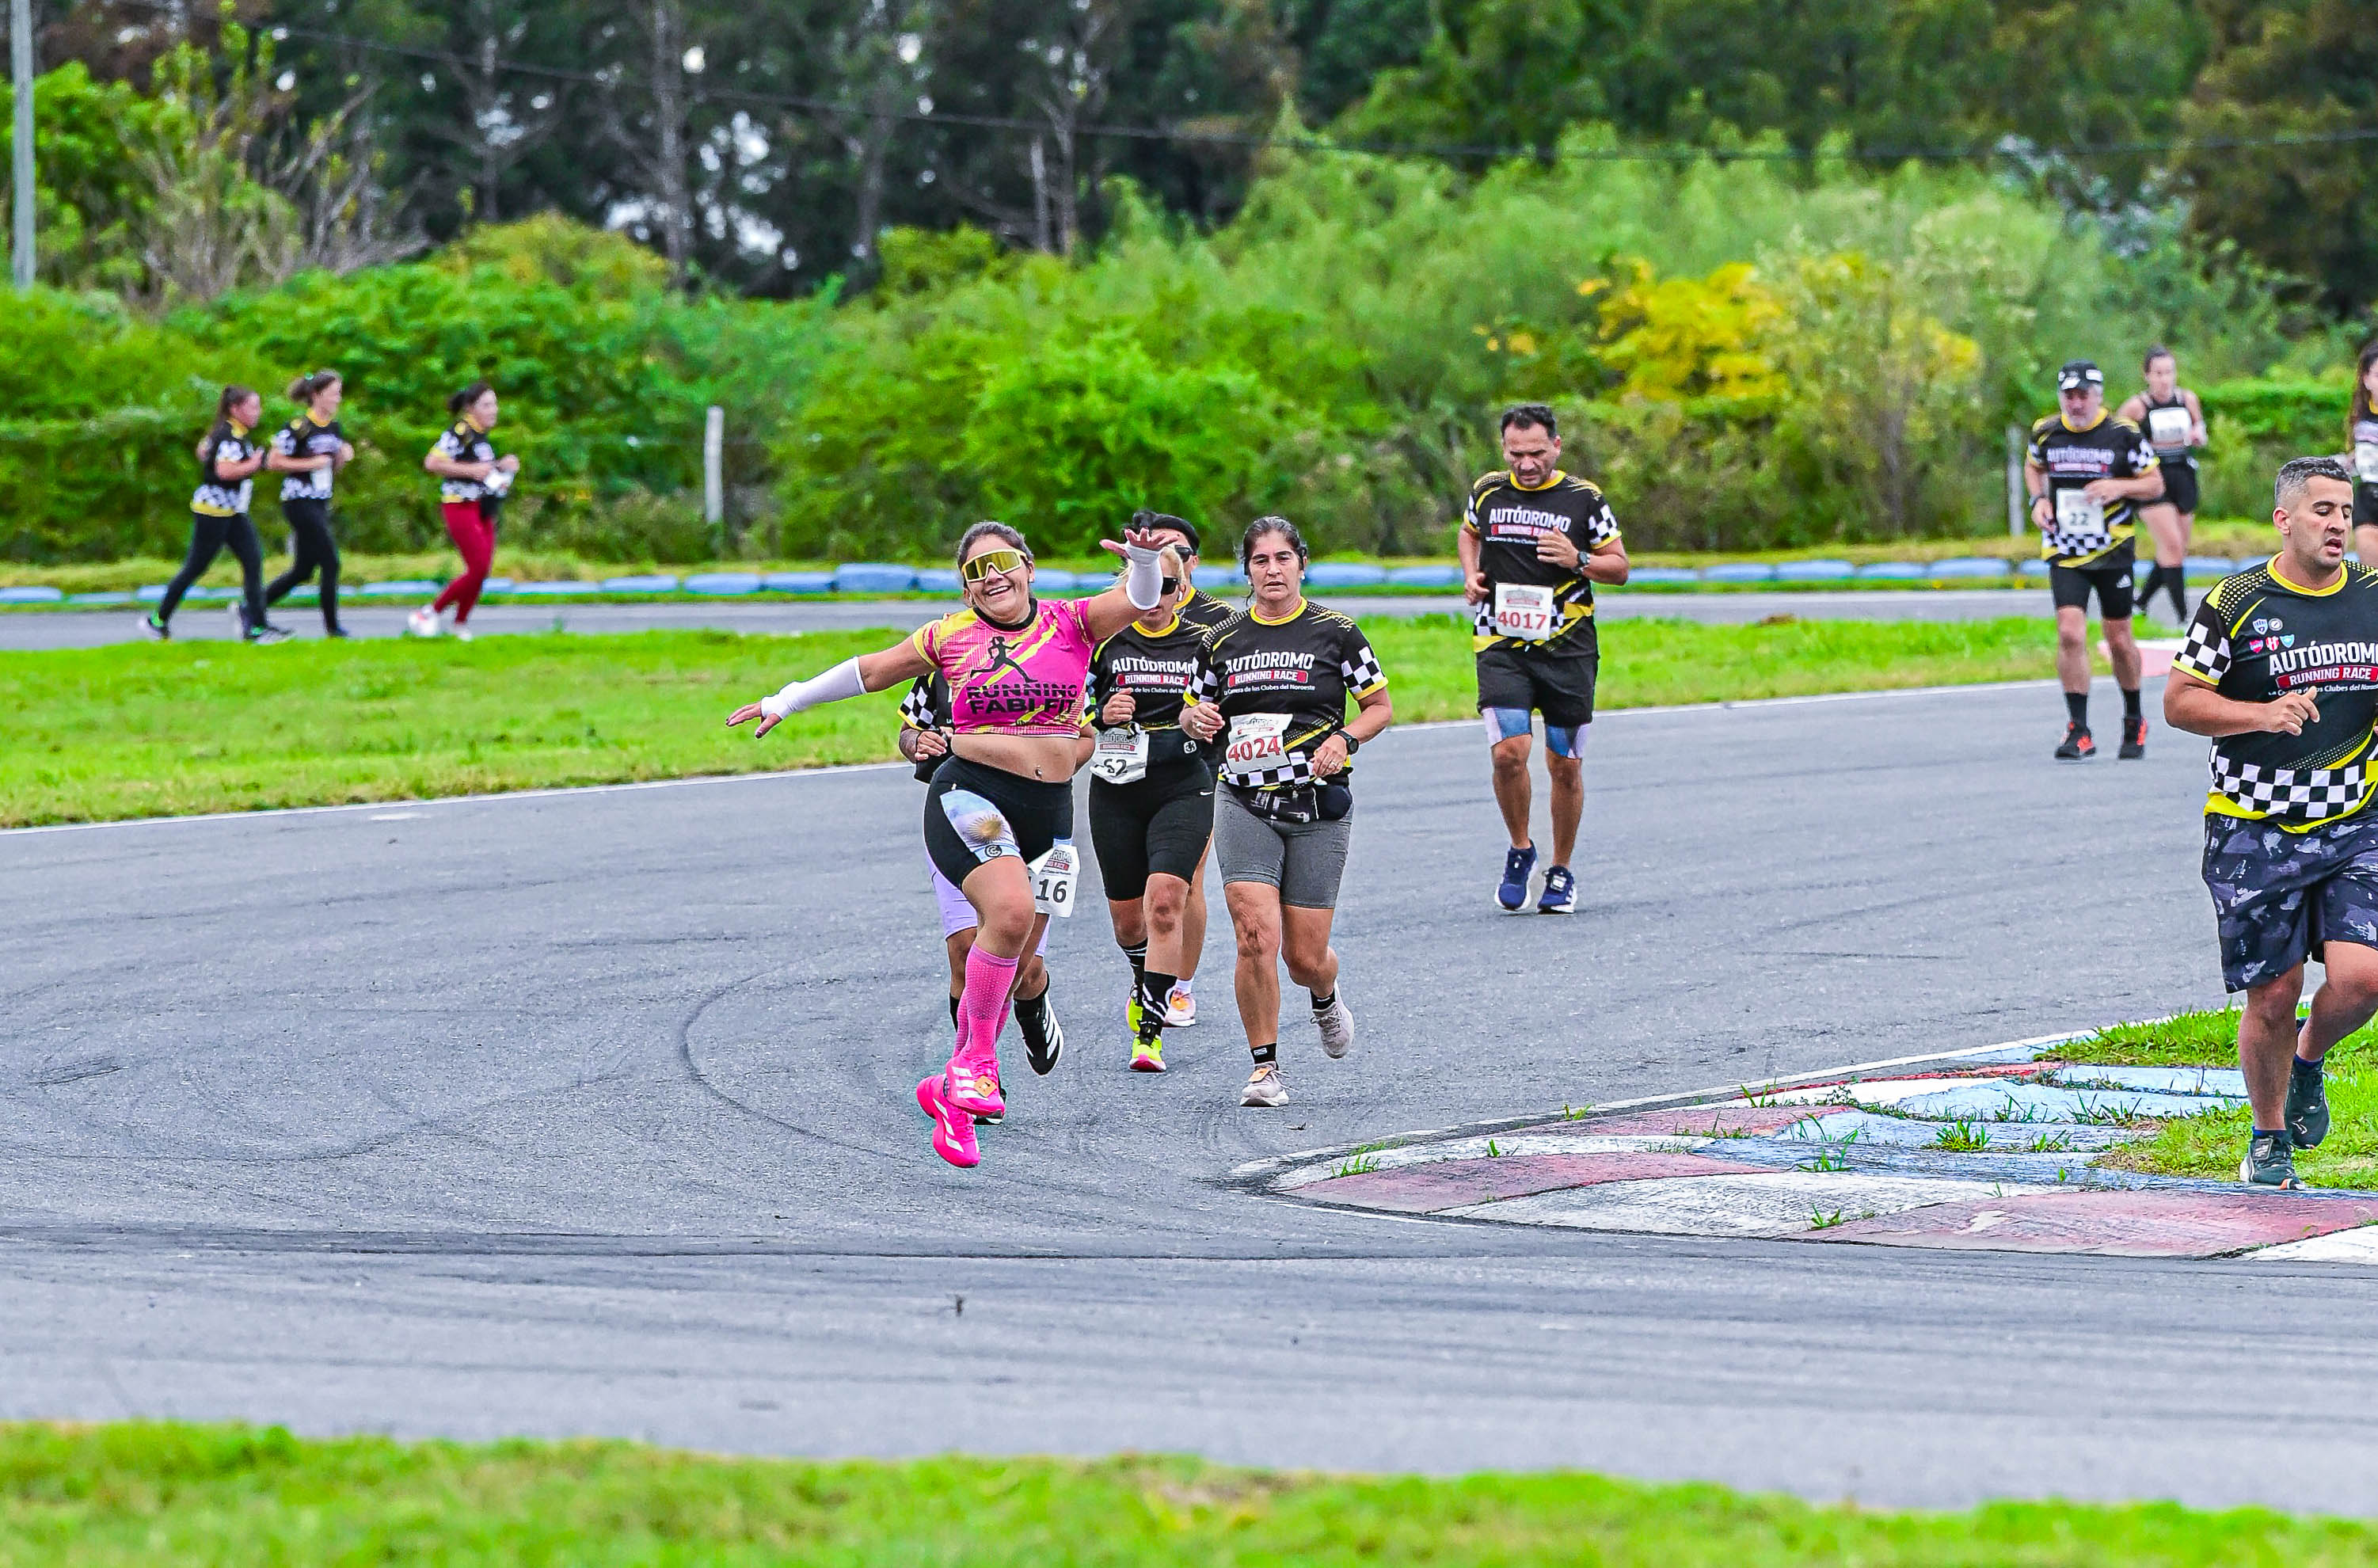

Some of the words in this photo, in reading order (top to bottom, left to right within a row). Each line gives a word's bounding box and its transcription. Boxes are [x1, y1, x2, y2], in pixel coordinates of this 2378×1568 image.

[1490, 505, 1571, 532] AUTÓDROMO
[1498, 611, 1547, 630] 4017
[1225, 649, 1315, 675] AUTÓDROMO
[2270, 641, 2378, 676] AUTÓDROM
[1124, 674, 1161, 684] RUNNING
[1162, 676, 1185, 686] RACE
[1235, 671, 1272, 685] RUNNING
[1273, 670, 1298, 681] RACE
[2289, 668, 2339, 686] RUNNING
[2342, 668, 2372, 679] RACE
[966, 683, 1078, 698] RUNNING
[968, 698, 1036, 714] FABI
[1044, 698, 1076, 716] FIT
[1228, 735, 1281, 763] 4024
